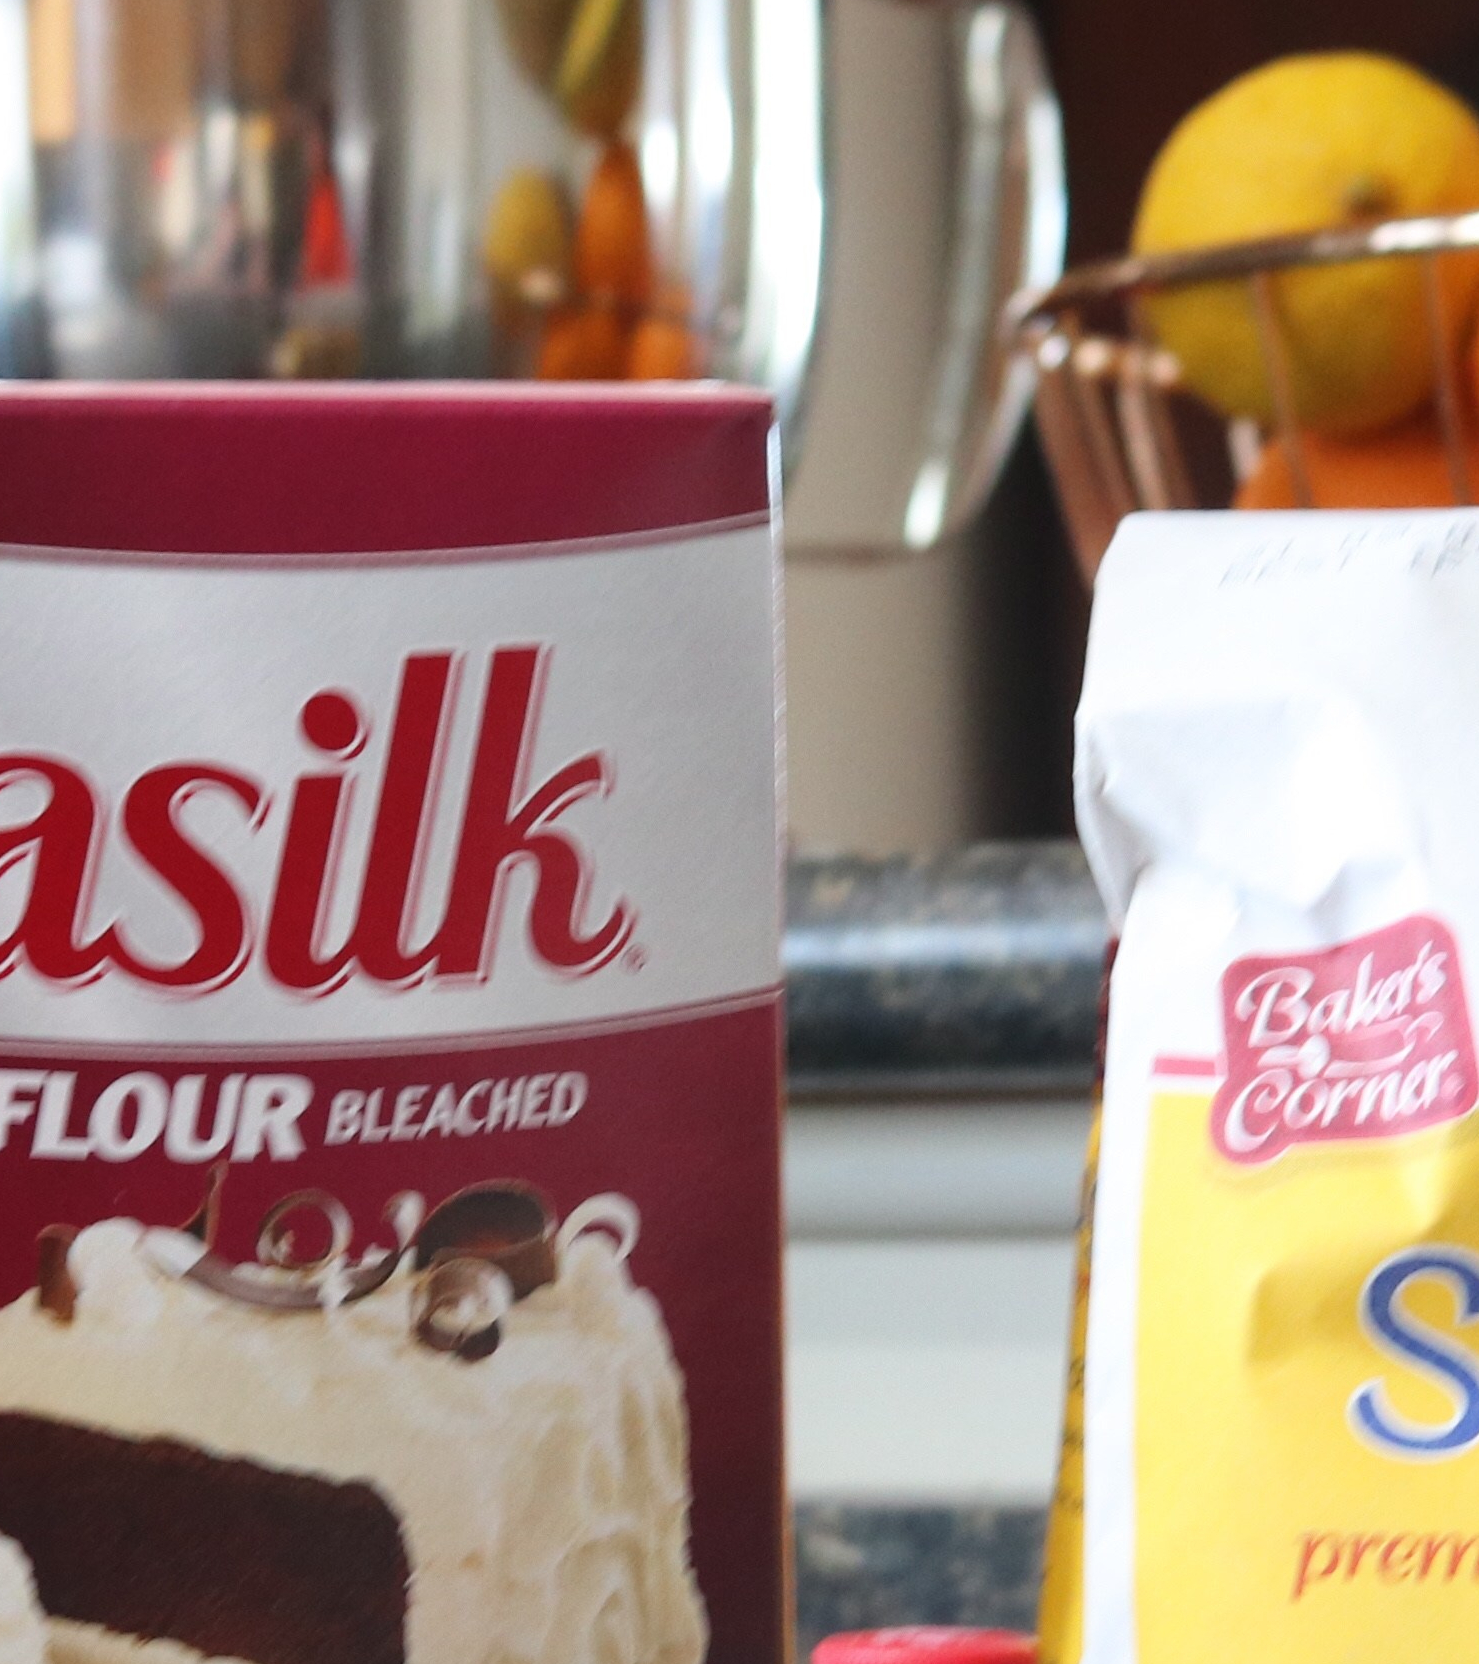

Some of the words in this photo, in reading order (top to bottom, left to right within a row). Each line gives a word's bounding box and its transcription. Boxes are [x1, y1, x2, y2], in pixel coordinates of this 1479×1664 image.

[1235, 938, 1450, 1048] Baker's
[324, 1070, 589, 1148] BLEACHED
[1223, 1048, 1460, 1154] Corner
